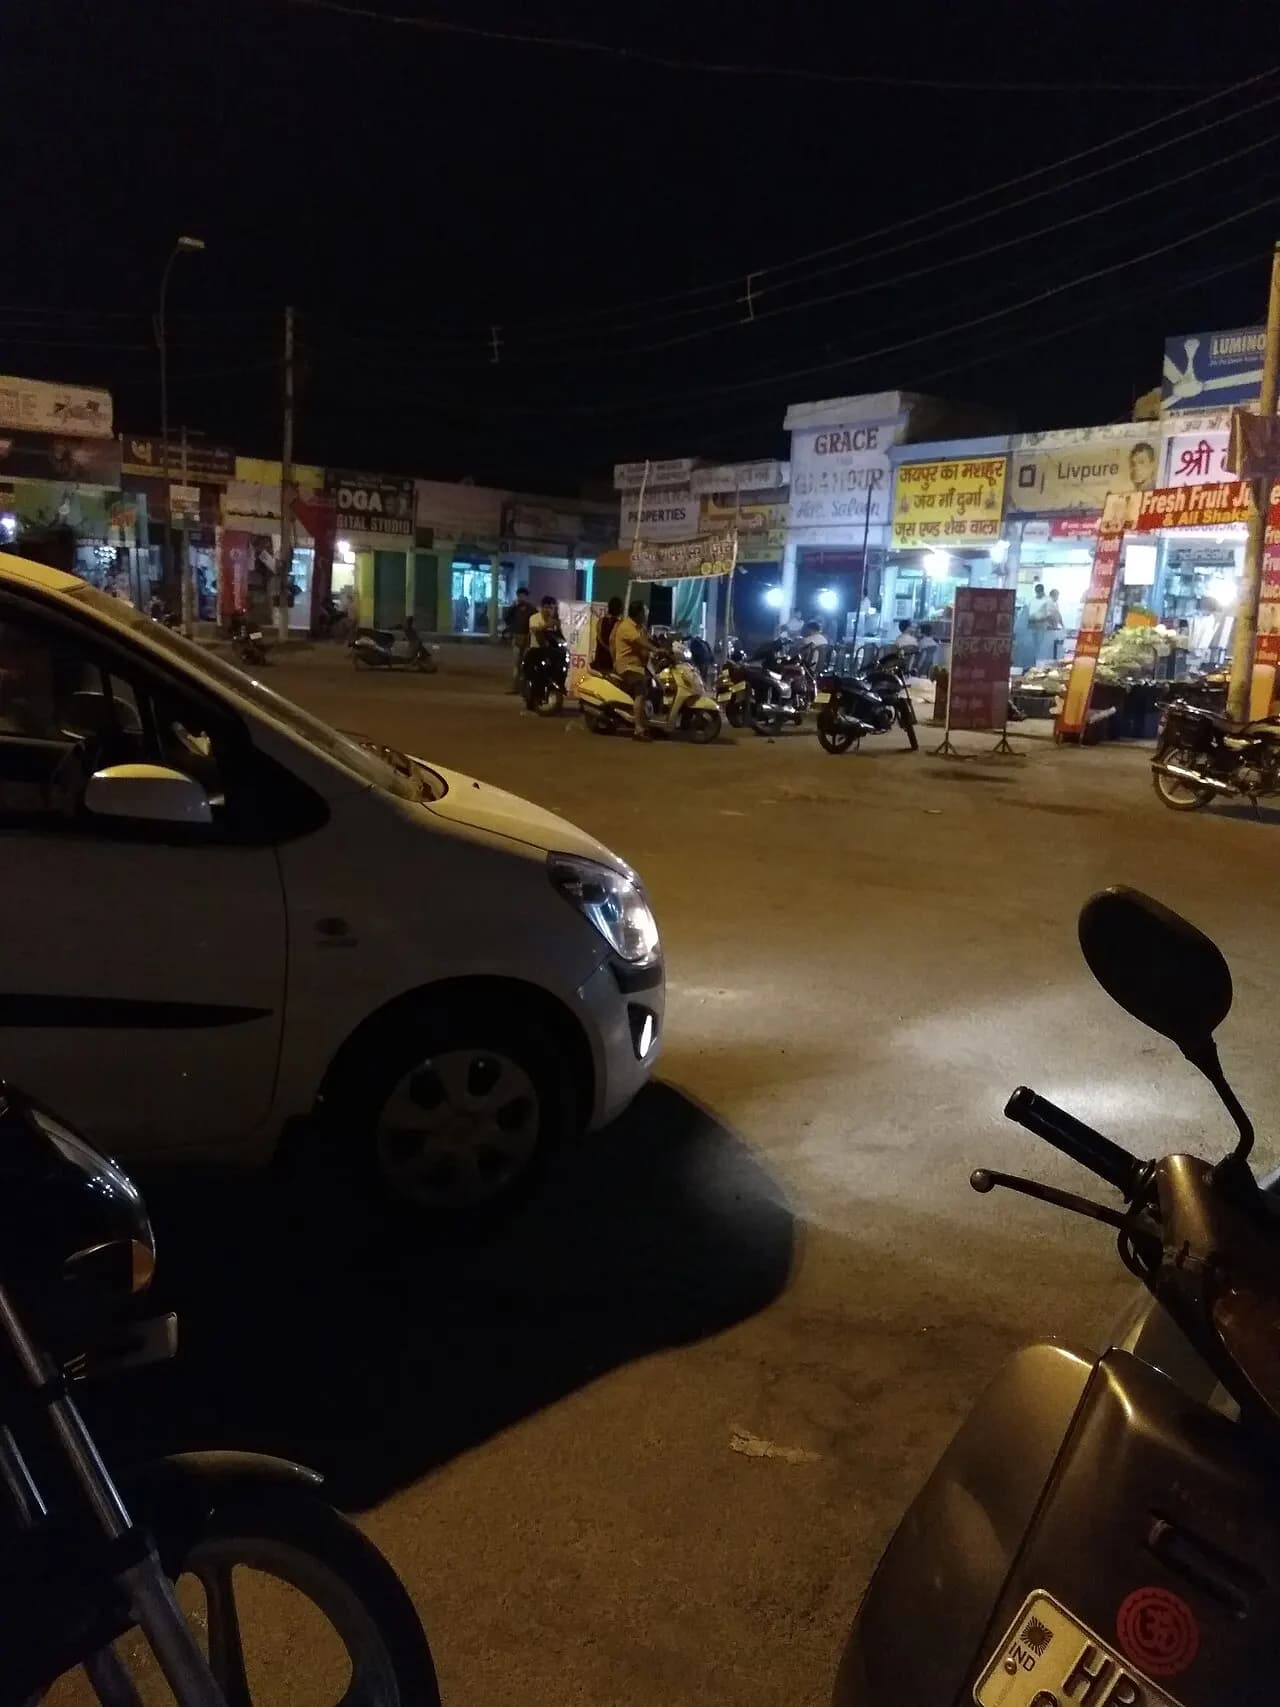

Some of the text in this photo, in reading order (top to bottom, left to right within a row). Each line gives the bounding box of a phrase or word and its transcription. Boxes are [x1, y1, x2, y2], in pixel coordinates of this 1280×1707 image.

[1212, 334, 1266, 356] LUMINO
[814, 426, 879, 454] GRACE
[1057, 461, 1120, 482] Livpure
[1175, 439, 1215, 476] श्री
[899, 459, 1005, 491] जयपुर का मशहूर
[331, 488, 382, 512] OGA
[913, 484, 984, 516] जय माँ दुर्गा
[1141, 488, 1186, 515] Fresh
[1188, 482, 1228, 511] Fruit
[337, 514, 411, 534] GITAL STUDIO
[628, 507, 687, 523] PROPERTIES
[894, 521, 916, 544] जूस
[944, 515, 968, 536] शेक
[970, 519, 999, 535] वाला
[1008, 1642, 1036, 1672] IND
